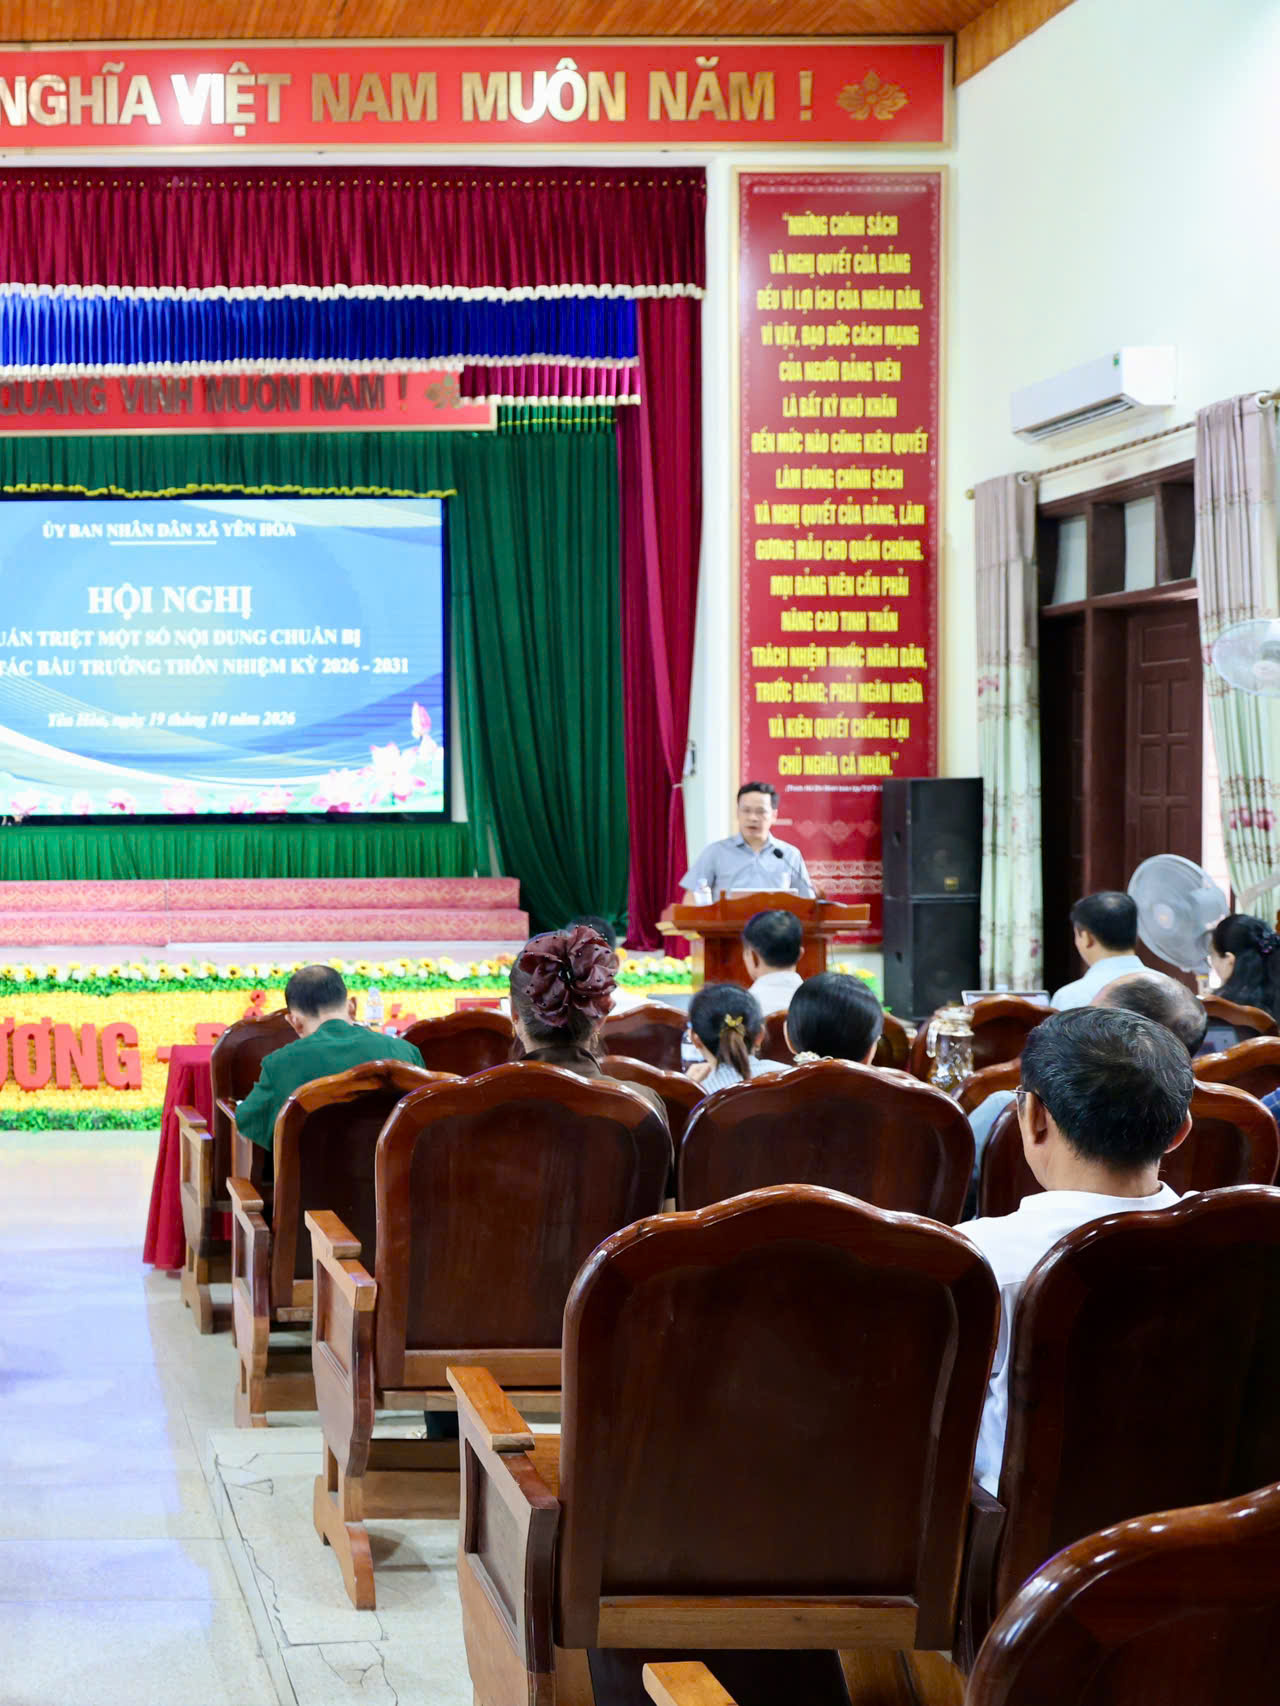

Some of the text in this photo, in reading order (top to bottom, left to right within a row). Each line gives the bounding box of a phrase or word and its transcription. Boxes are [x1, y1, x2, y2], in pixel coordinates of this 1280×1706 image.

[171, 61, 291, 137] VIỆT
[311, 71, 438, 124] NAM
[461, 57, 626, 124] MUÔN
[648, 55, 775, 122] NĂM
[798, 71, 813, 121] !
[119, 375, 194, 414] VINH
[87, 581, 253, 621] HỘI NGHỊ
